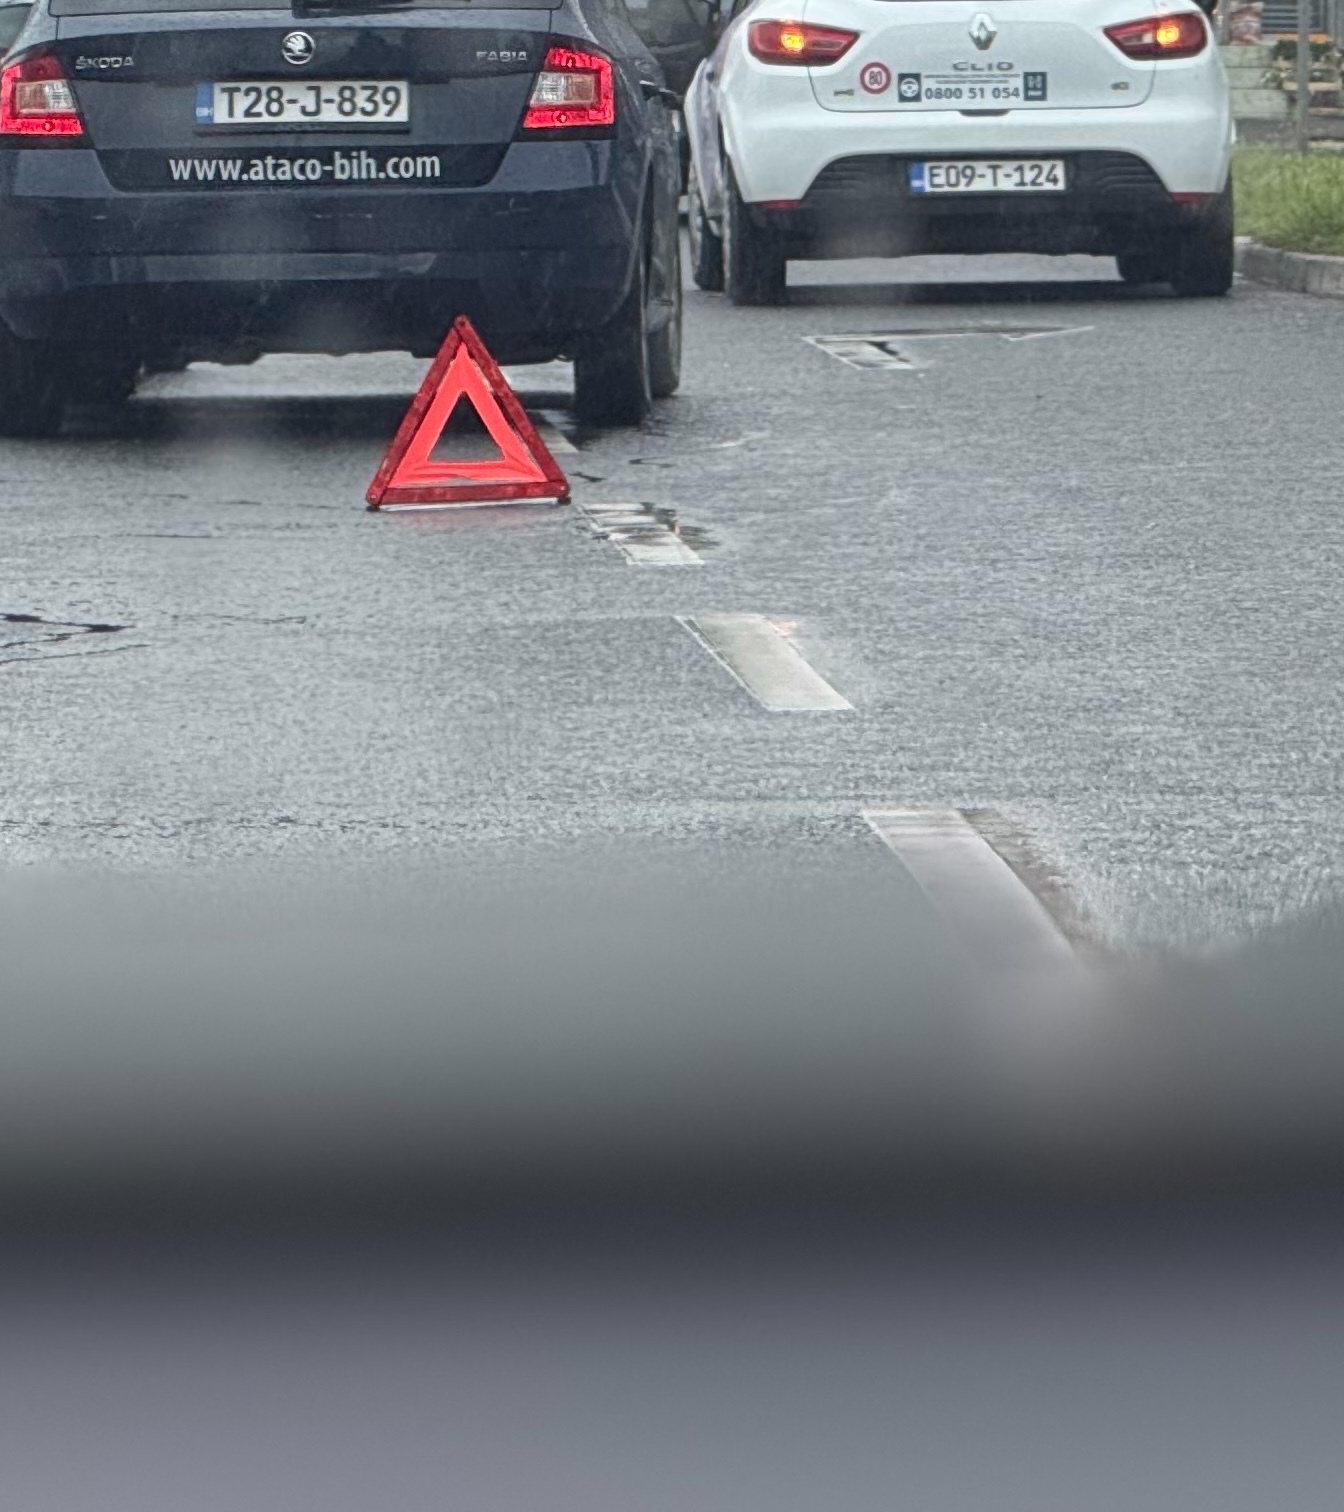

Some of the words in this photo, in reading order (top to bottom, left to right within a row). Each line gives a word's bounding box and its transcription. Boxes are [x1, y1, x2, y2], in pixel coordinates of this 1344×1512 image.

[475, 50, 528, 64] FABIA
[952, 61, 1015, 72] CLIO
[867, 70, 884, 87] 80
[221, 85, 402, 119] T28-J-839
[924, 87, 964, 100] 0800
[967, 88, 986, 100] 51
[991, 87, 1021, 100] 054
[168, 150, 442, 182] www.ataco-bih.com
[928, 163, 1060, 189] E09-T-124
